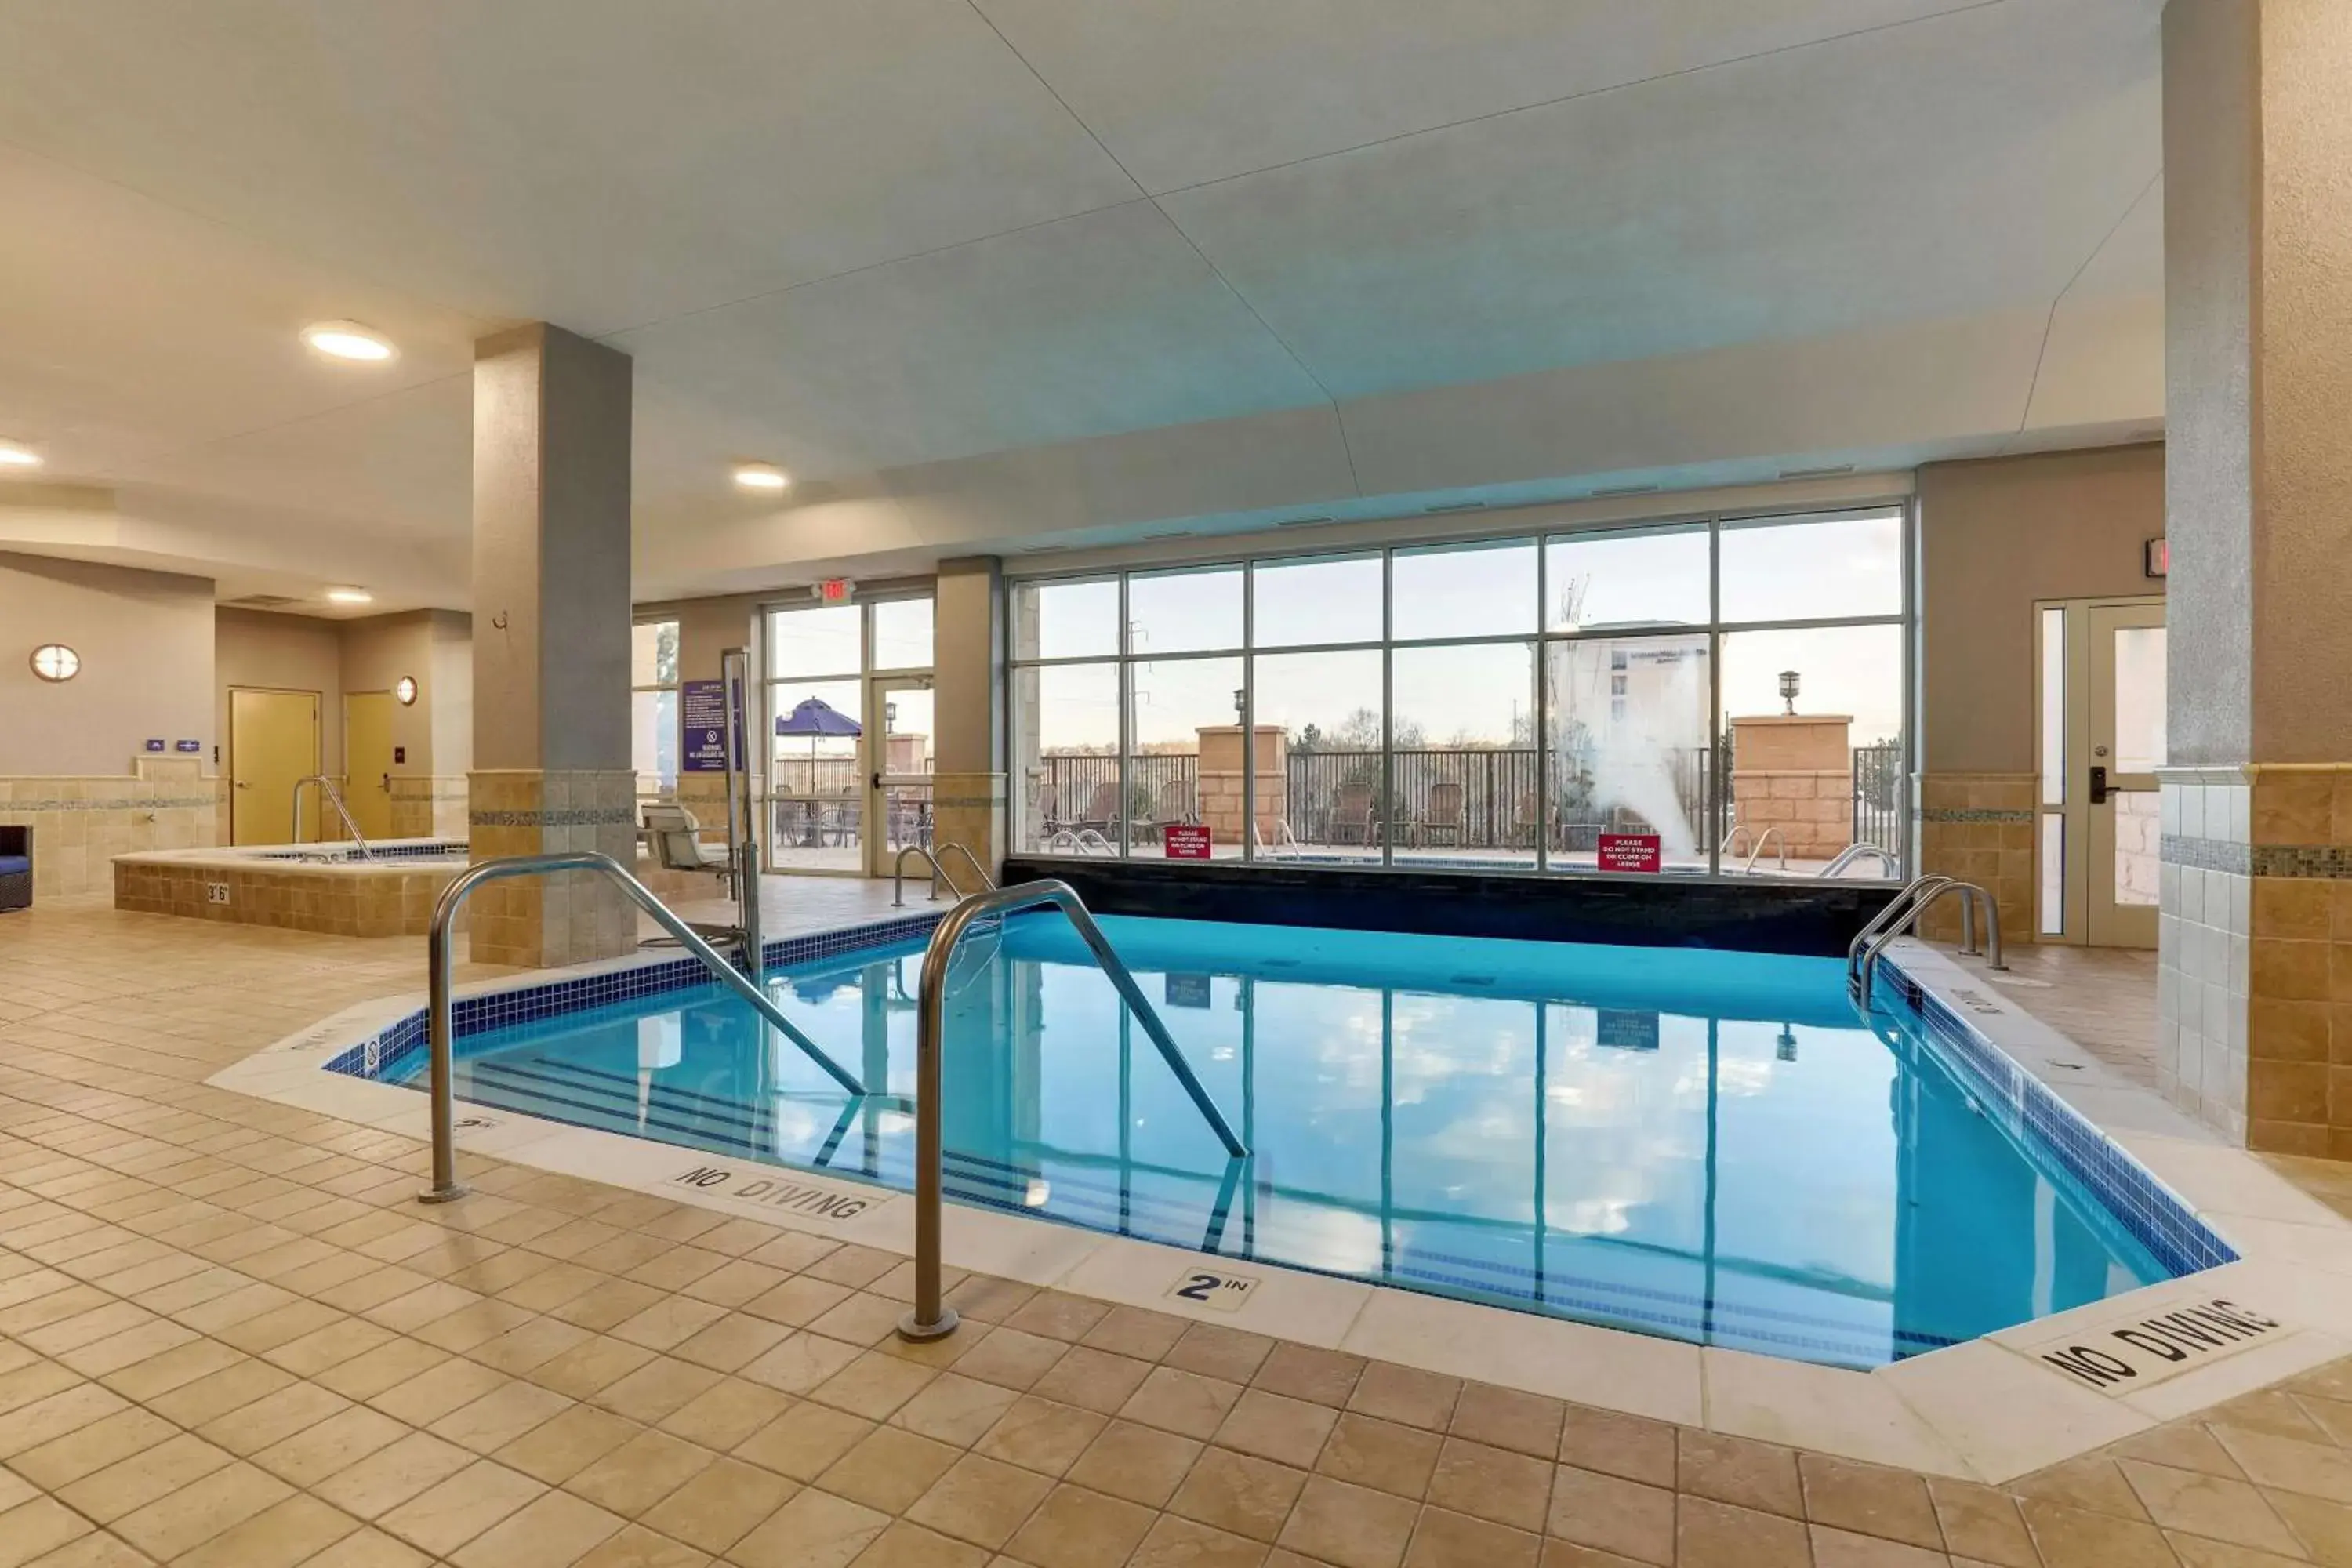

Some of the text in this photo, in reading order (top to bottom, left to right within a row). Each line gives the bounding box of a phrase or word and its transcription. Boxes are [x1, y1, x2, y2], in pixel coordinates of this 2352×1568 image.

[675, 1166, 866, 1220] NO DIVING
[1177, 1274, 1249, 1301] 2 IN
[2041, 1345, 2138, 1388] NO
